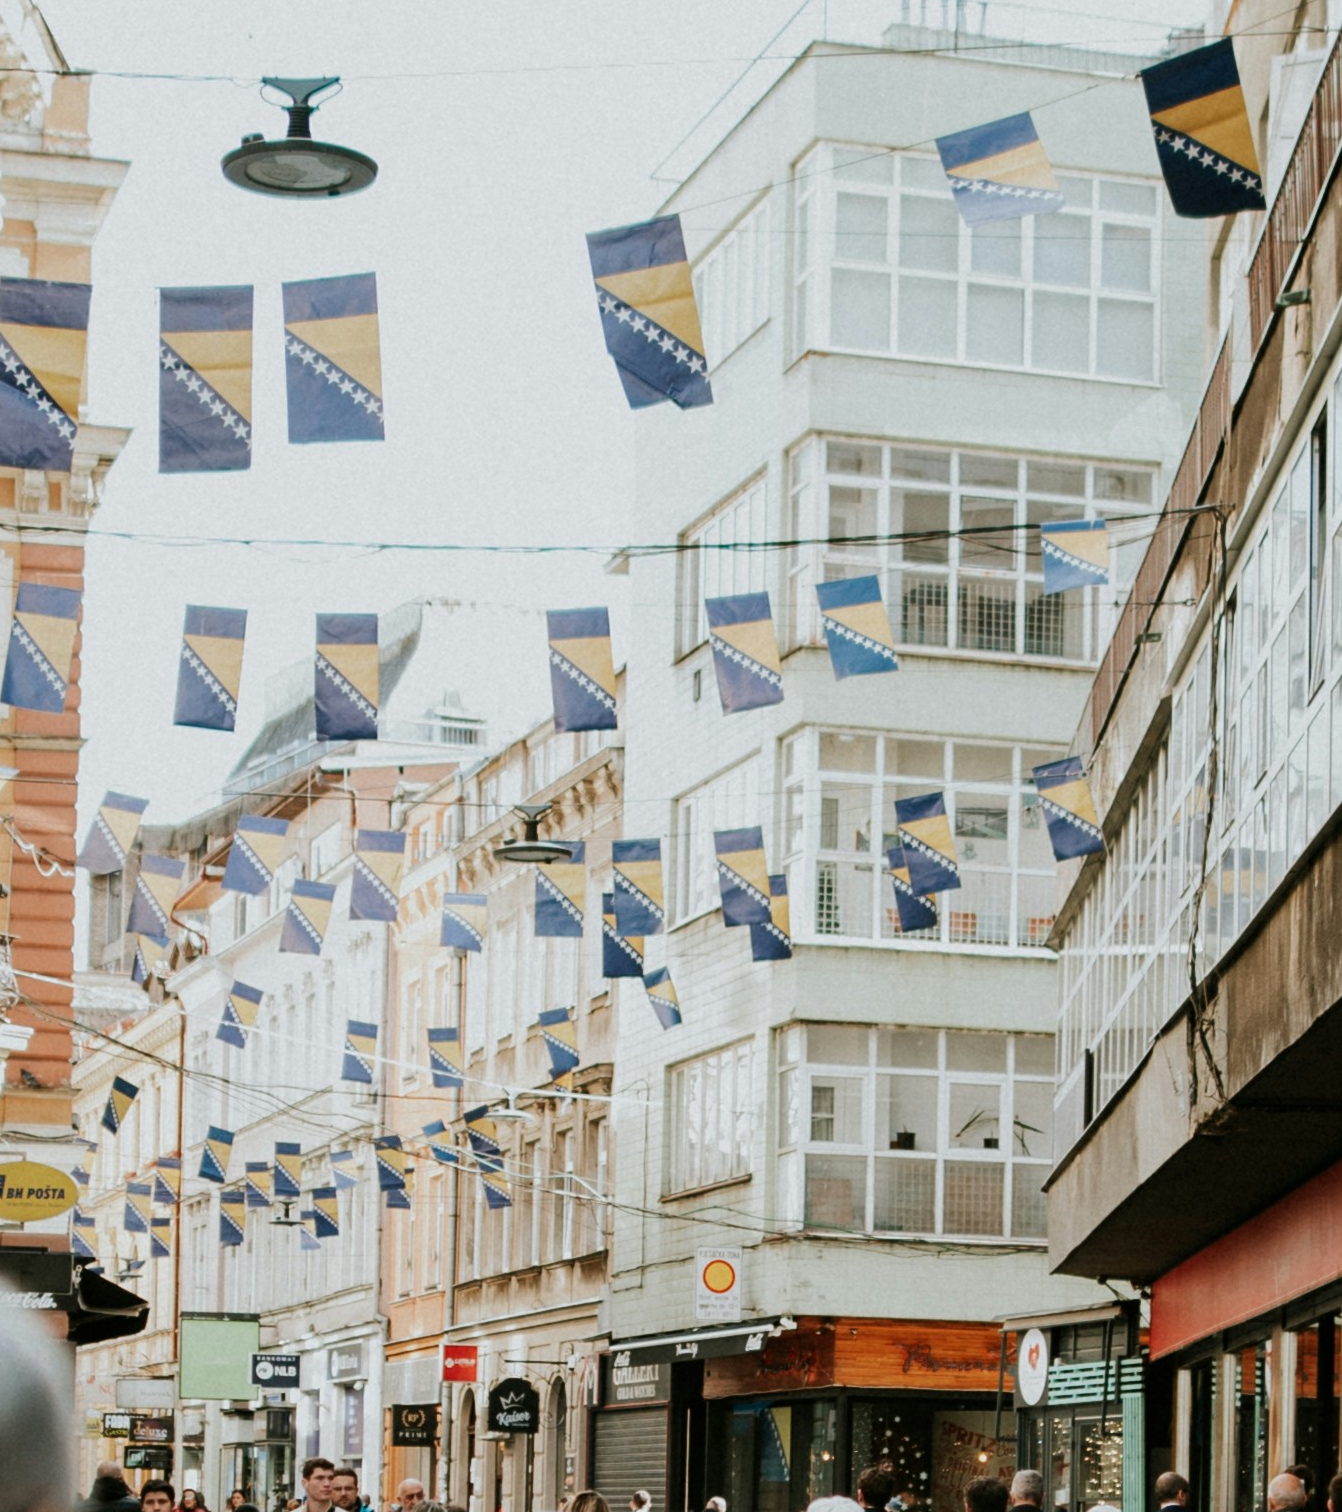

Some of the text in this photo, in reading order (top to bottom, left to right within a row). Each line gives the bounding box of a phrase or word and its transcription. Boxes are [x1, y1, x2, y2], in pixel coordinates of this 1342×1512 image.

[6, 1185, 66, 1200] BH POŠTA
[274, 1366, 297, 1377] NLB
